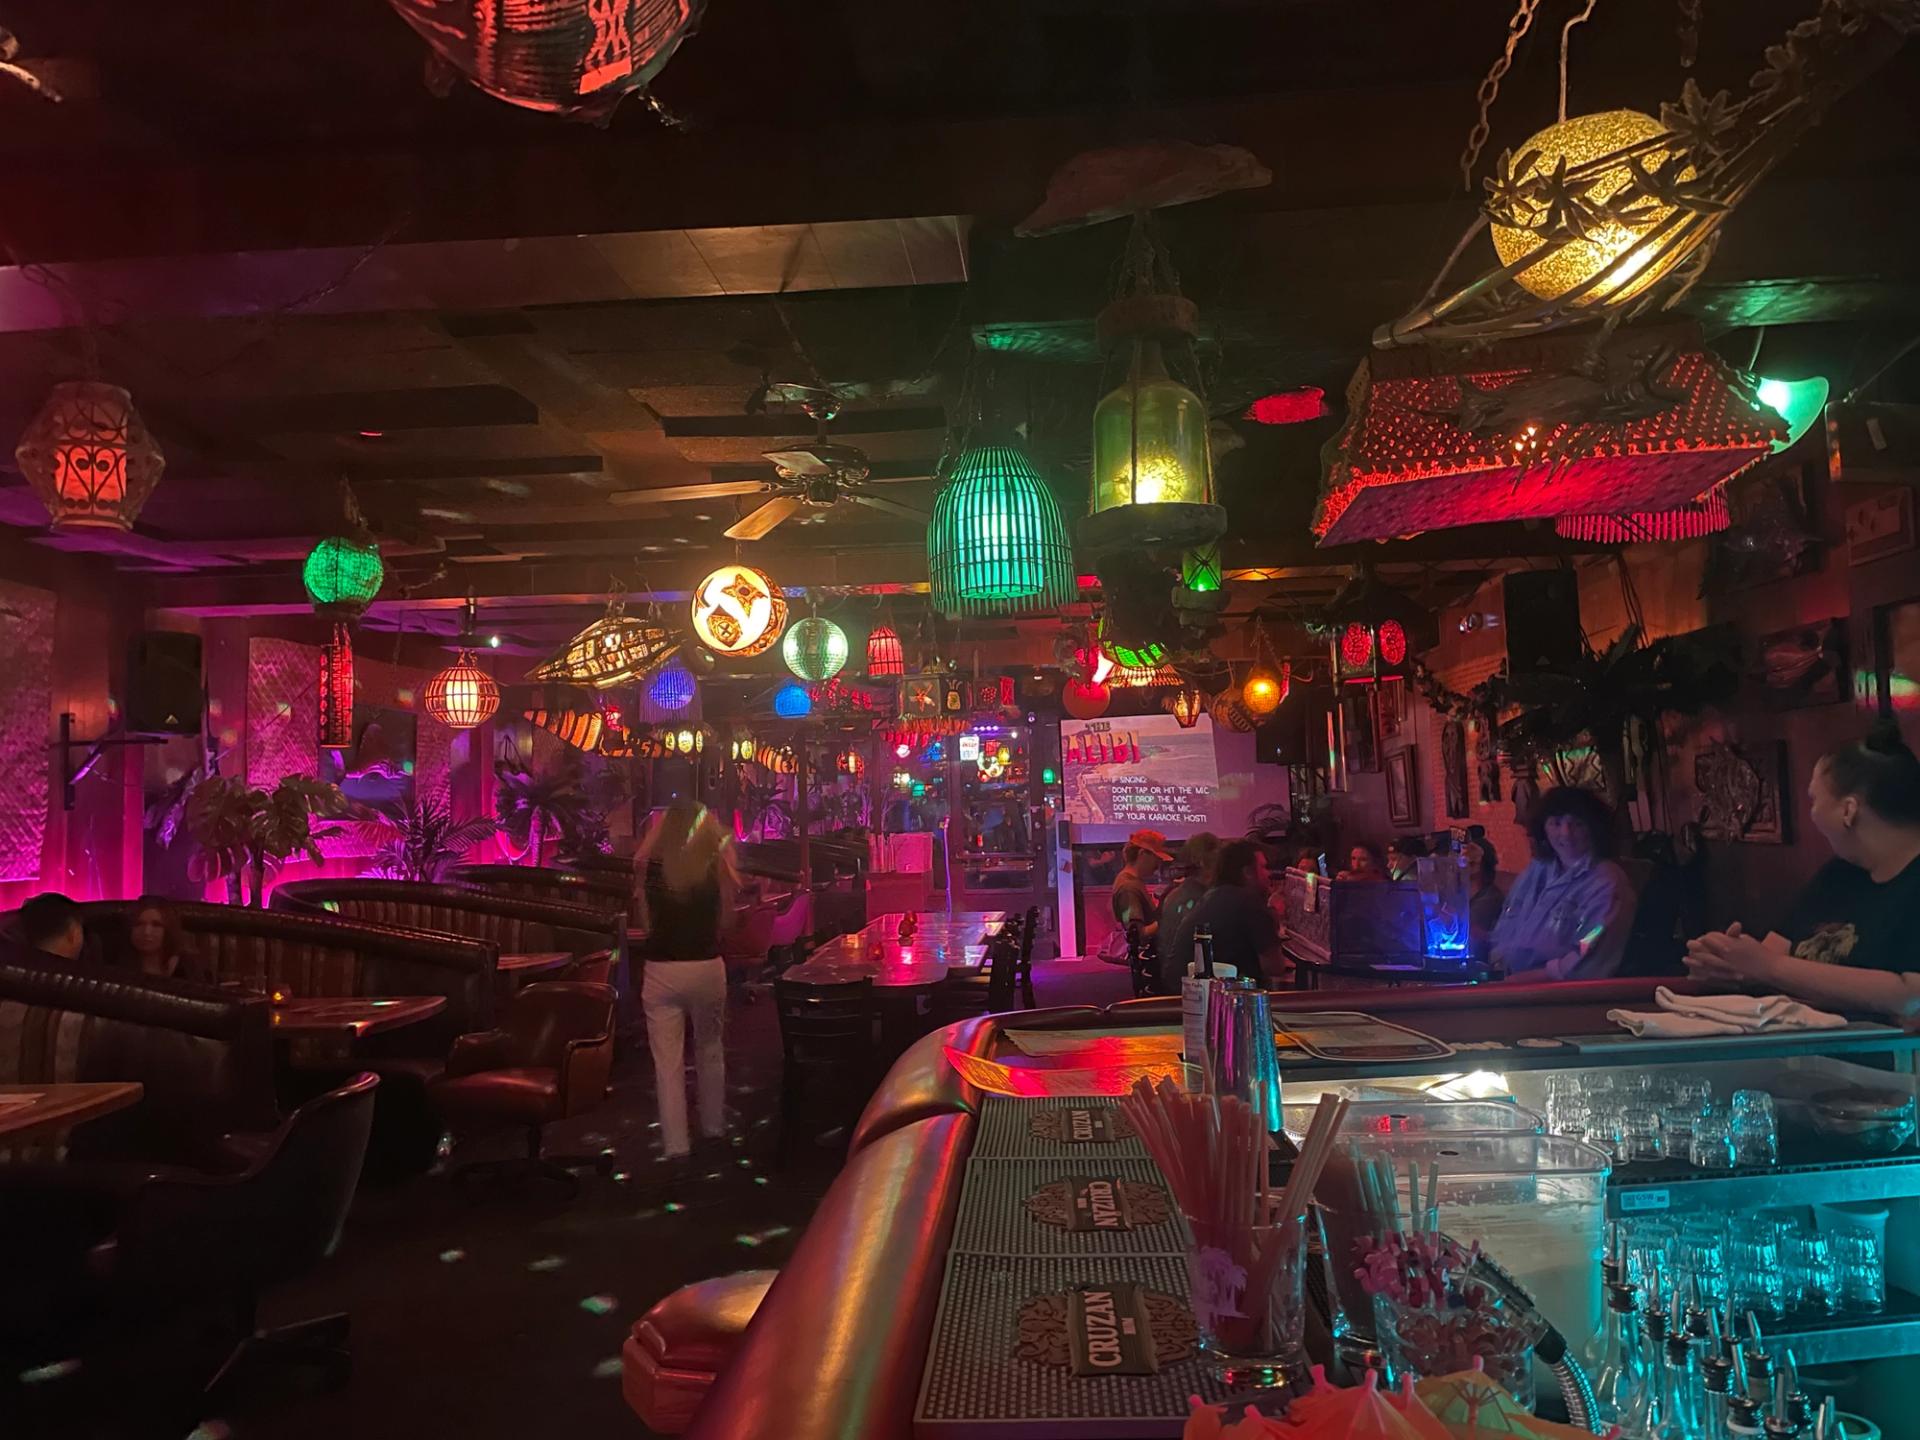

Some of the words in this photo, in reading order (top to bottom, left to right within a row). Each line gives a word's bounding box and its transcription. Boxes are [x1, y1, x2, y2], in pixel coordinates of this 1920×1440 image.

[1085, 721, 1111, 733] THE
[1066, 730, 1141, 765] ALIBI
[1136, 804, 1159, 812] SWING
[1157, 796, 1171, 804] THE
[1148, 813, 1181, 822] KARAOKE
[1183, 814, 1207, 823] HOST!
[1072, 1110, 1093, 1140] CRUZAN
[1089, 1181, 1118, 1226] CRUZAN
[1083, 1291, 1122, 1367] CRUZAN
